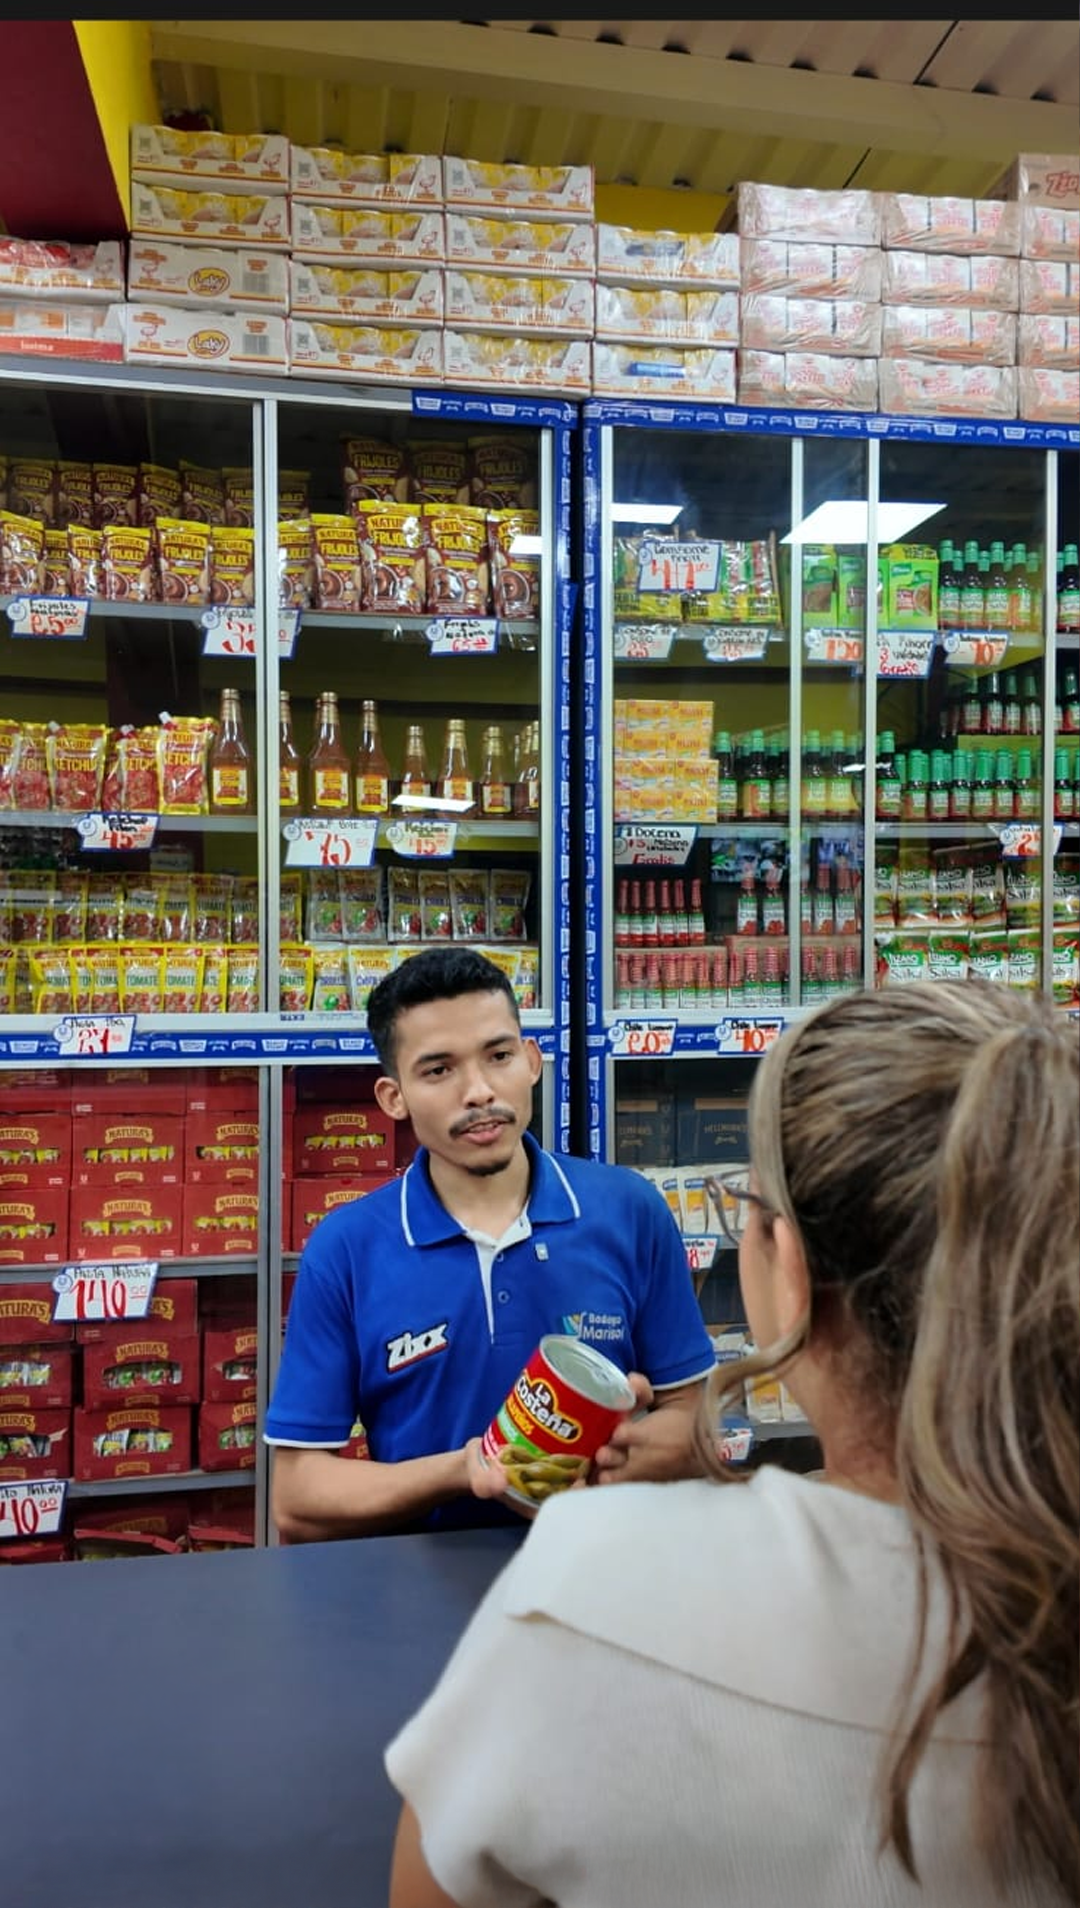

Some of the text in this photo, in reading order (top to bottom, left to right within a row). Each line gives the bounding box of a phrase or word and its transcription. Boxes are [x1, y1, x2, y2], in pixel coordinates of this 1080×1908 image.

[929, 966, 960, 978] Salsa
[0, 1130, 36, 1140] ATURA'S
[0, 1204, 32, 1215] TURA'S
[583, 1325, 625, 1341] Marisol
[535, 1384, 552, 1405] La
[517, 1376, 577, 1438] Costeña
[0, 1414, 33, 1426] TURA'S
